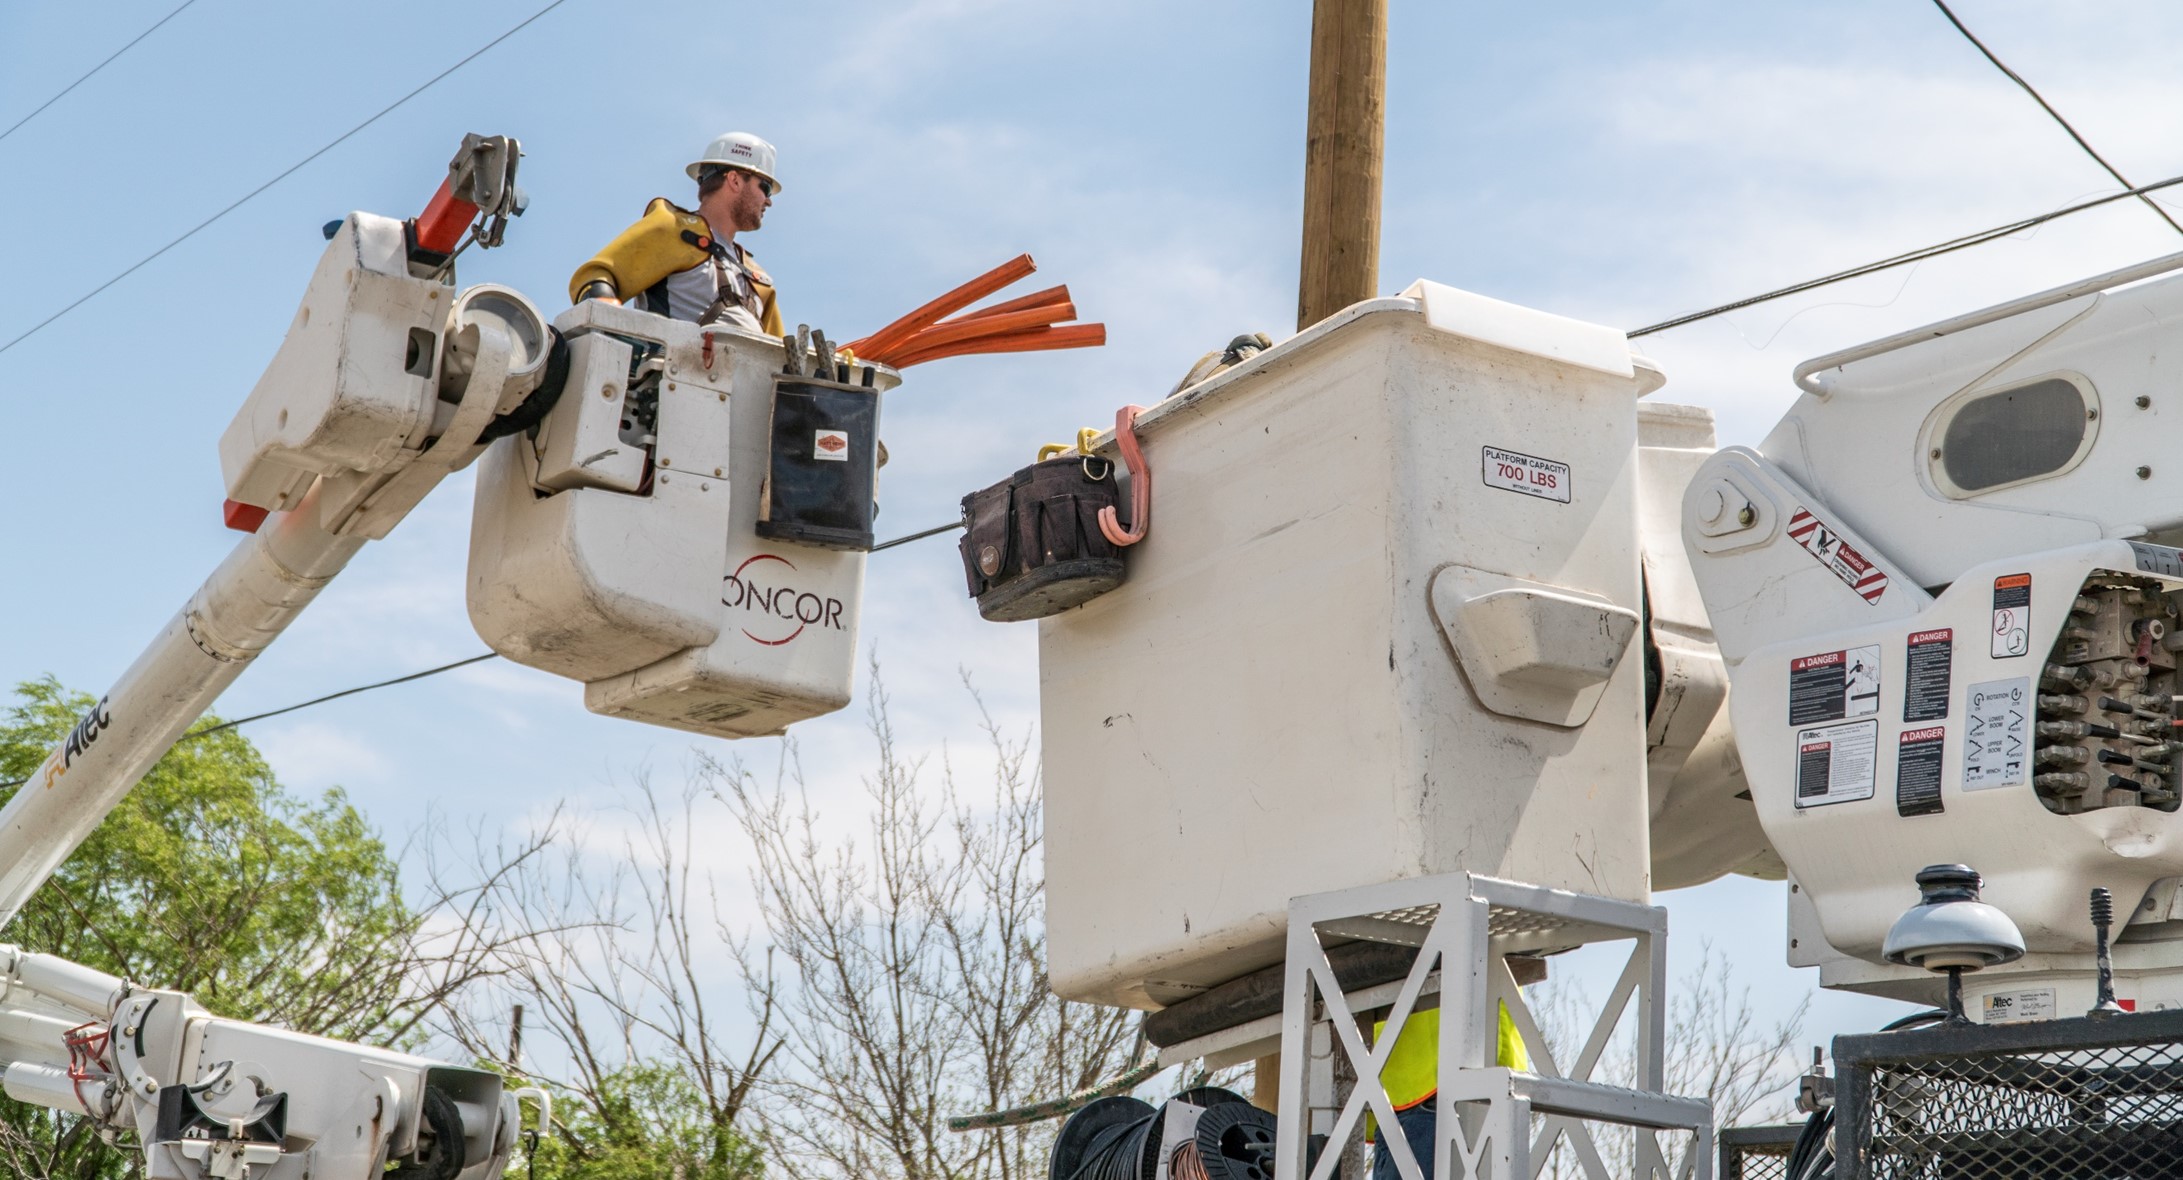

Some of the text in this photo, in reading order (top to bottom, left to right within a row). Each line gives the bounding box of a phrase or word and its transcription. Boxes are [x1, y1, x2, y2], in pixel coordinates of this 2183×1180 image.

[731, 149, 753, 158] SAFETY
[1486, 450, 1566, 474] PLATFORM CAPACITY
[1497, 463, 1557, 489] 700 LBS
[1844, 551, 1865, 571] DANGER
[722, 575, 842, 631] ONCOR
[1920, 632, 1948, 642] DANGER
[1807, 653, 1839, 667] DANGER
[1986, 692, 2009, 701] ROTATION
[1988, 715, 2004, 723] LOWER
[65, 695, 109, 769] Altec
[1909, 728, 1943, 741] DANGER
[1808, 742, 1828, 751] DANGER
[1987, 740, 2003, 748] UPPER
[1993, 997, 2012, 1008] Altec
